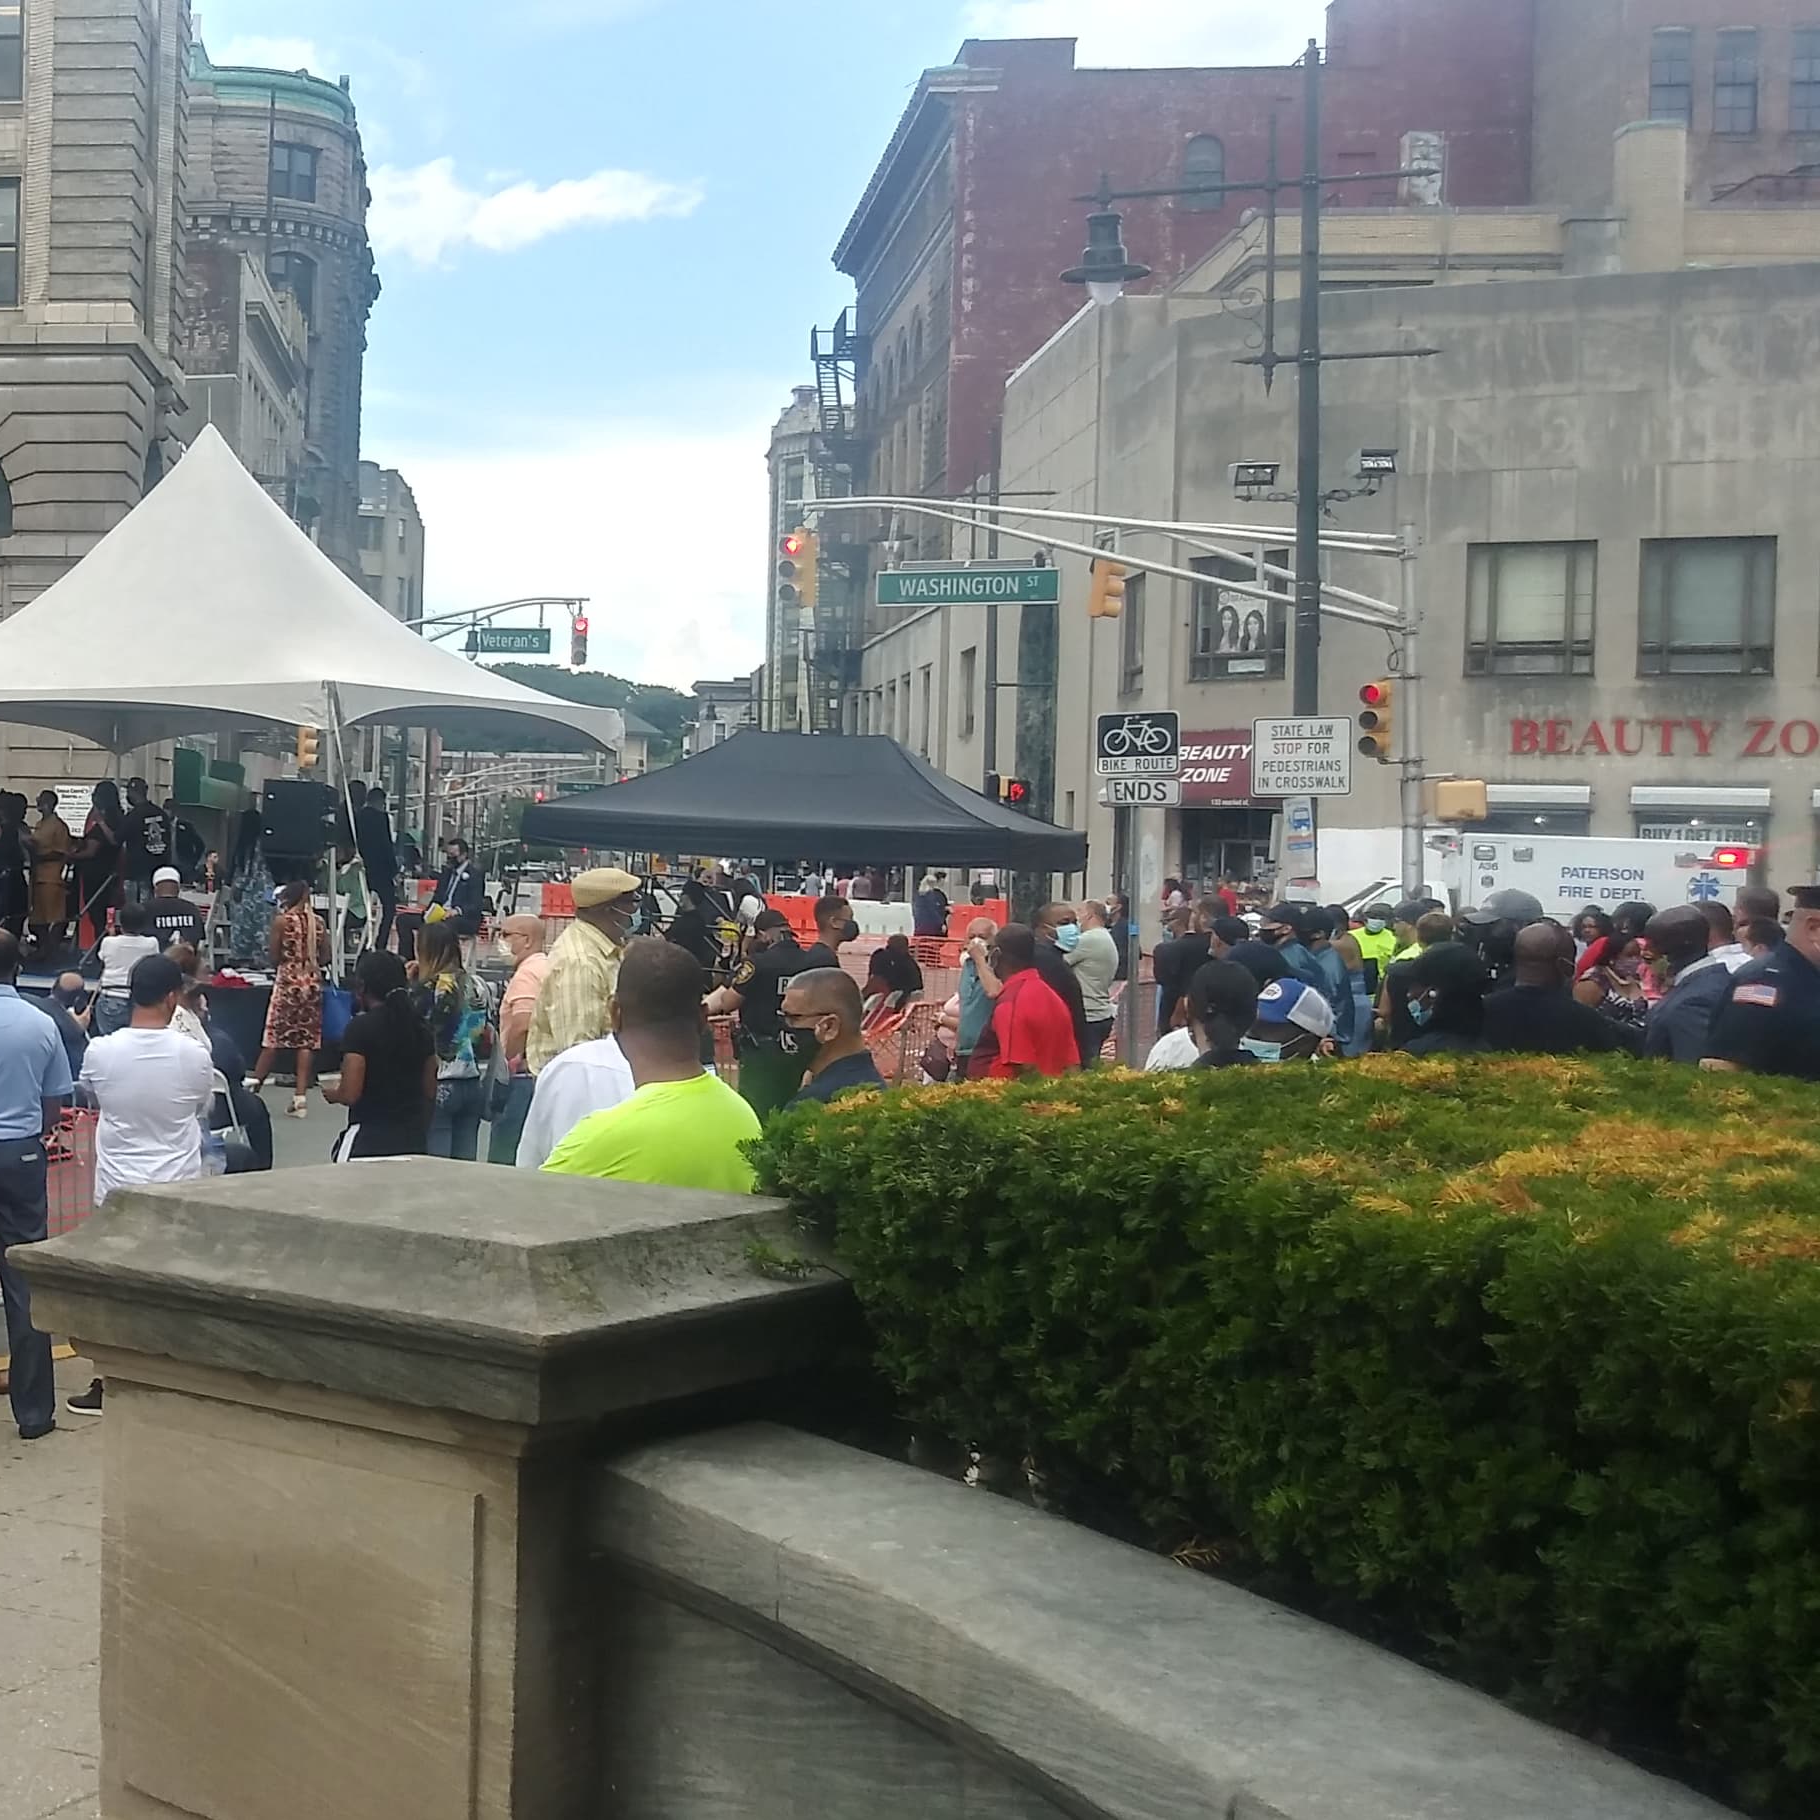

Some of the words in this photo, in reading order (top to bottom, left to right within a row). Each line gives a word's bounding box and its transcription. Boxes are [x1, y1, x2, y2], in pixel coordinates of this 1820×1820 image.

[899, 576, 1020, 597] WASHINGTON
[1027, 576, 1040, 588] ST
[482, 633, 540, 648] Veteran's
[1271, 725, 1304, 738] STATE
[1310, 724, 1334, 737] LAW
[1509, 718, 1721, 757] BEAUTY
[1179, 744, 1253, 761] BEAUTY
[1273, 743, 1303, 755] STOP
[1307, 743, 1331, 755] FOR
[1101, 758, 1128, 772] BIKE
[1135, 757, 1174, 771] ROUTE
[1262, 759, 1342, 773] PEDESTRIANS
[1181, 767, 1233, 783] ZONE
[1258, 777, 1269, 789] IN
[1275, 776, 1347, 789] CROSSWALK
[1114, 782, 1168, 802] ENDS
[1642, 828, 1670, 840] BUY
[1684, 829, 1711, 842] GET
[1725, 830, 1760, 845] FREE
[1561, 866, 1645, 881] PATERSON
[1559, 886, 1594, 899] FIRE
[1600, 887, 1646, 901] DEPT.
[155, 915, 194, 929] FIGHTER
